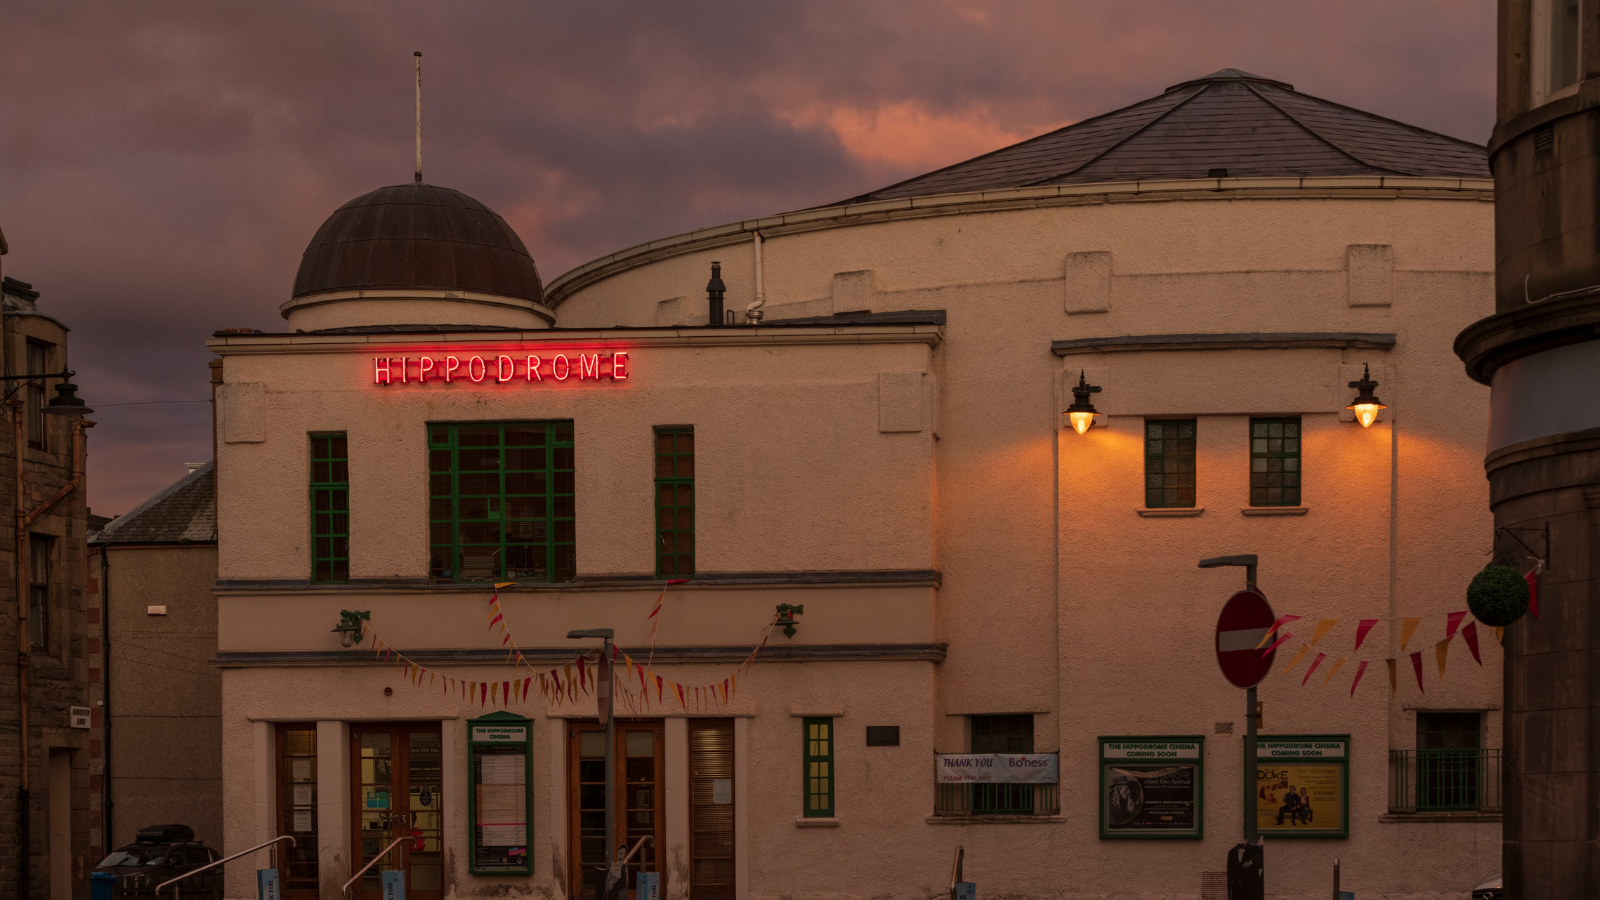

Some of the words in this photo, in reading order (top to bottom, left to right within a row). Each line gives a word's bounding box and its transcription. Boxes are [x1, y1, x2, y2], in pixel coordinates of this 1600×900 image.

[373, 352, 628, 383] HIPPODROME
[944, 758, 973, 767] THANK
[975, 758, 993, 767] YOU
